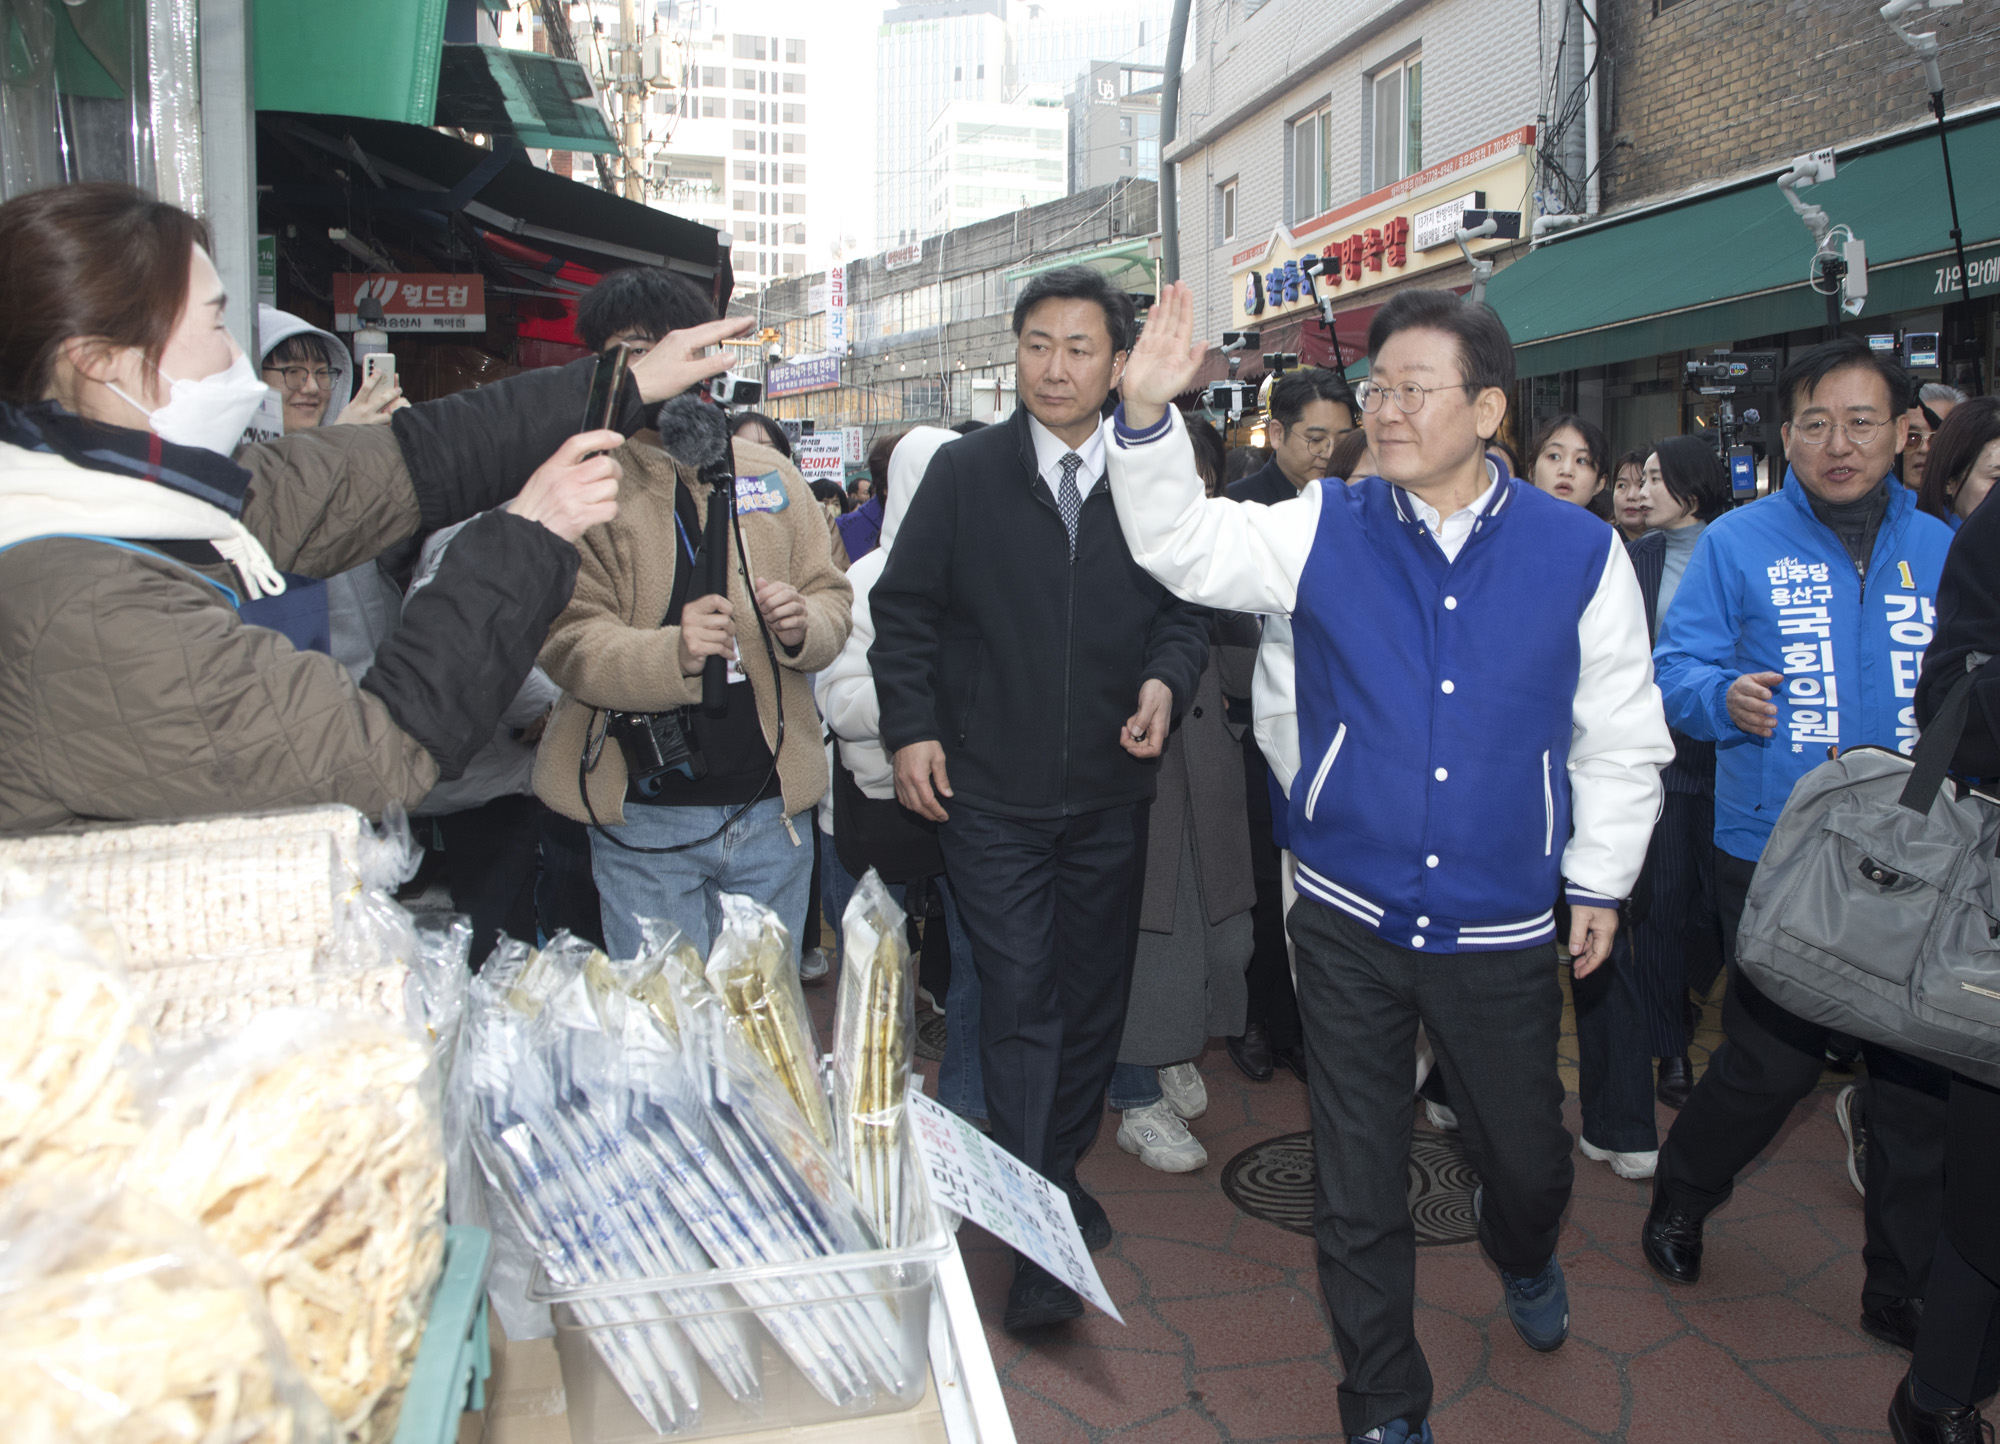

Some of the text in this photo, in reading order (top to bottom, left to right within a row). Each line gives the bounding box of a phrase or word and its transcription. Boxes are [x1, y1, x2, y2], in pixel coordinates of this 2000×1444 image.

[1323, 216, 1409, 287] 한방족발
[401, 283, 469, 308] 월드컵
[831, 267, 843, 308] 싱크대
[831, 312, 843, 339] 가구
[801, 457, 841, 470] 모이자!
[1767, 563, 1830, 586] 민주당
[1897, 560, 1916, 590] 1
[1770, 585, 1834, 607] 용산구
[1777, 606, 1840, 744] 국회의원
